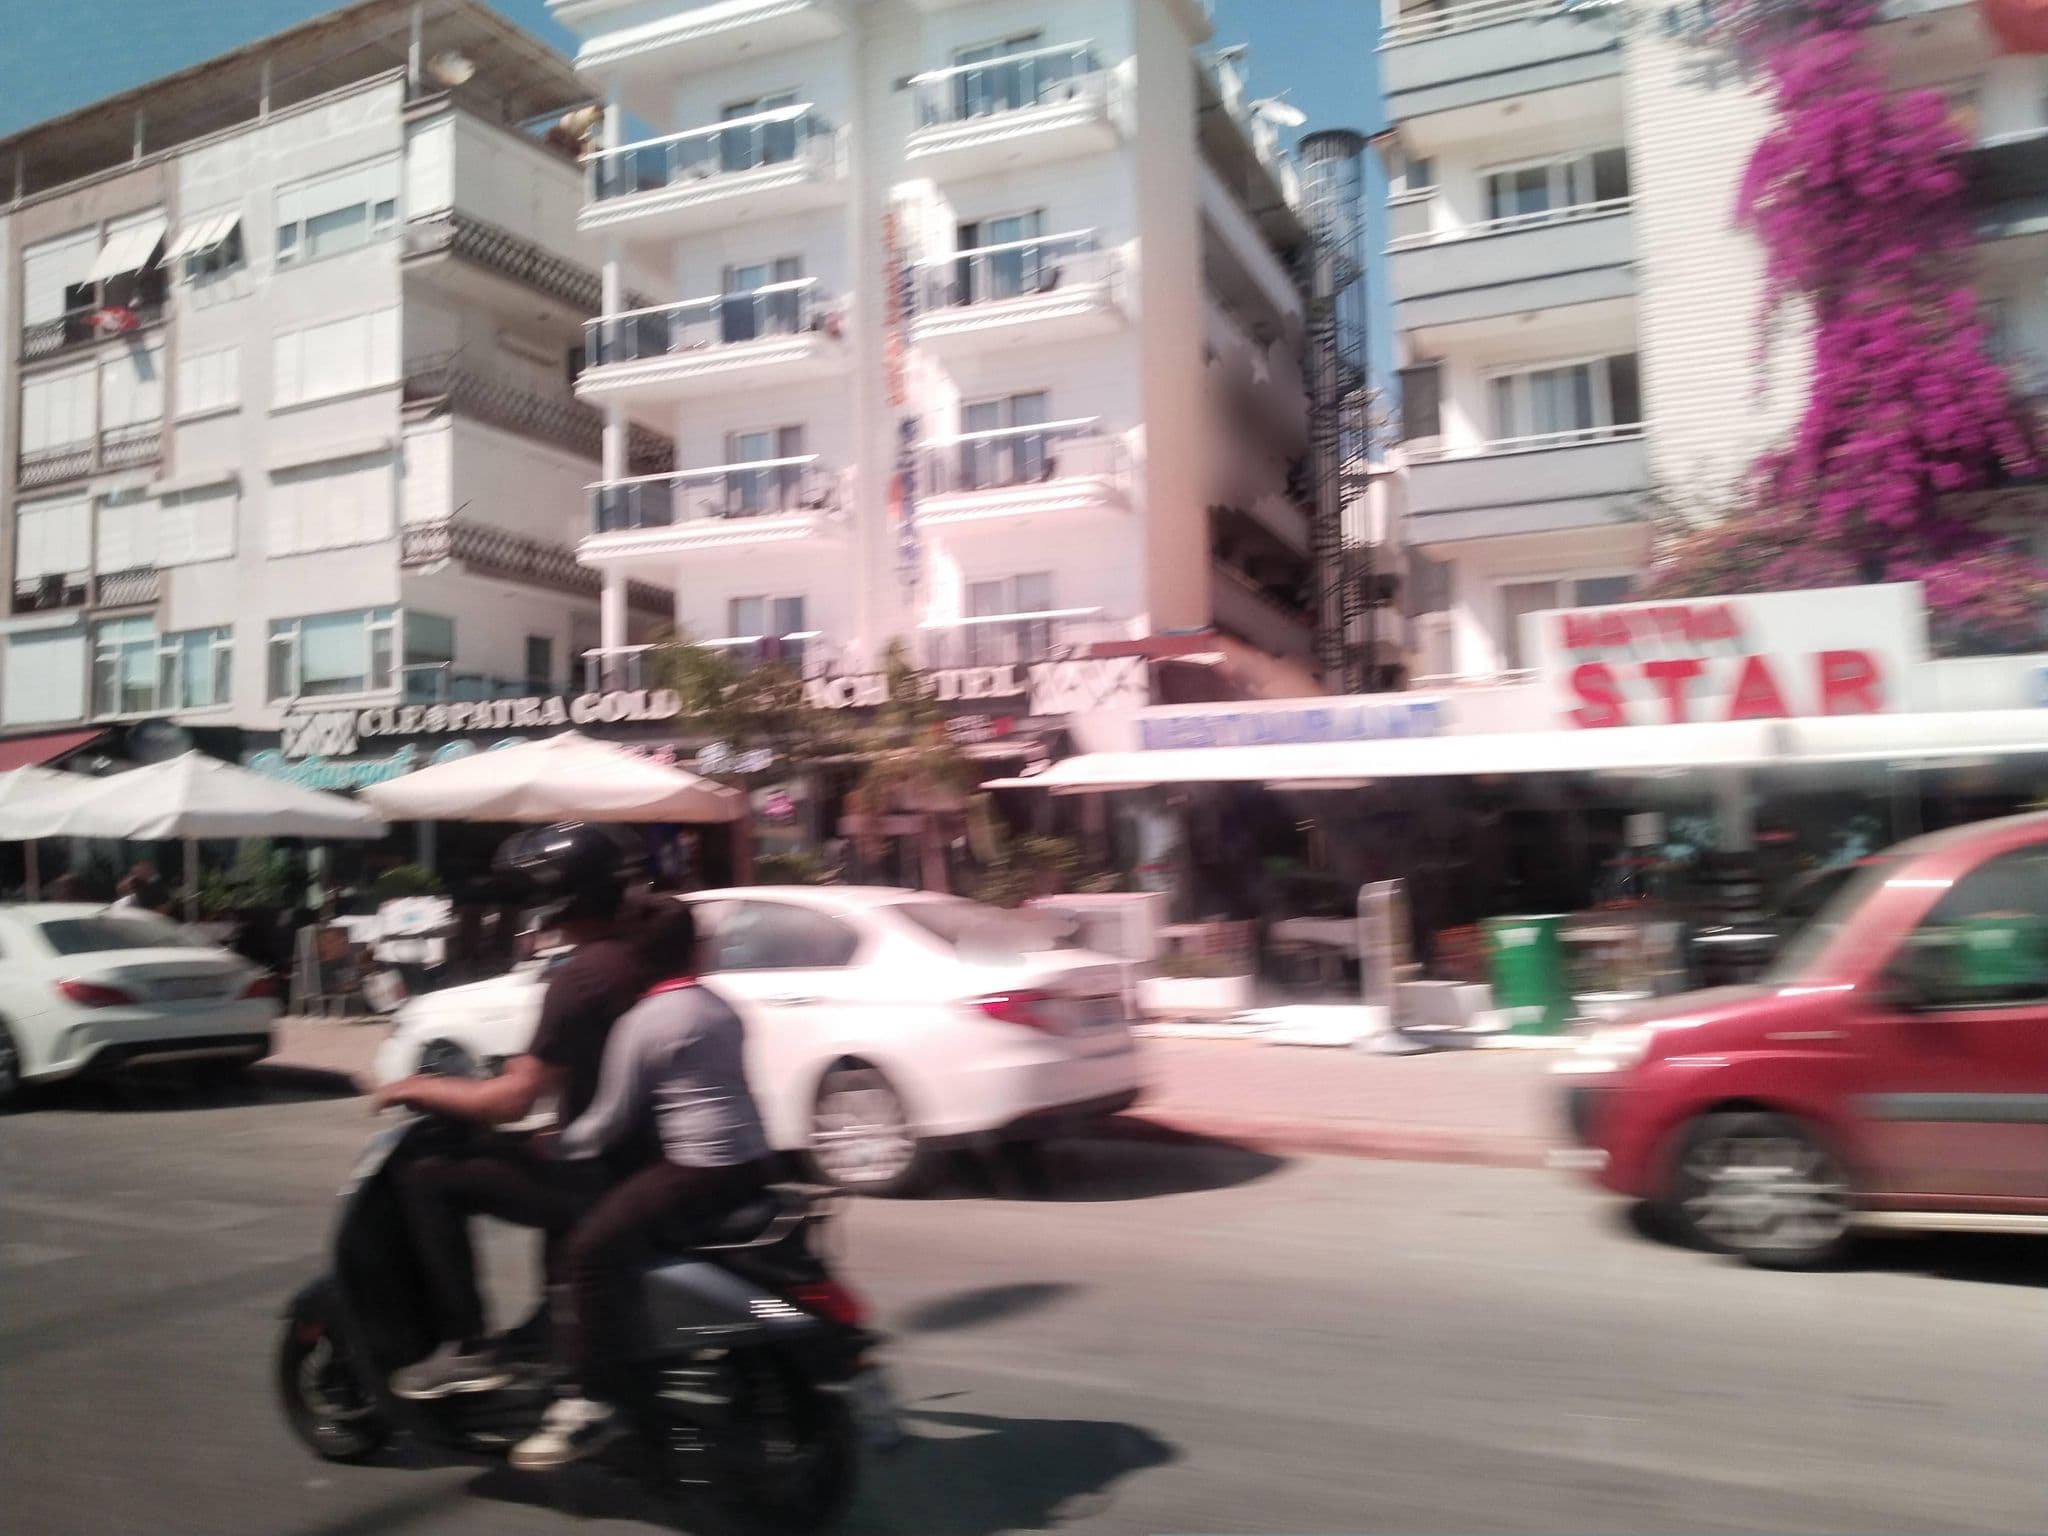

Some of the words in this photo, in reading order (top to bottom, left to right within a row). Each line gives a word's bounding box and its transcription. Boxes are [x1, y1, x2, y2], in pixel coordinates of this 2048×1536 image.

[356, 695, 569, 737] CLEOPATRA
[571, 688, 682, 725] GOLD
[1565, 648, 1890, 729] STAR
